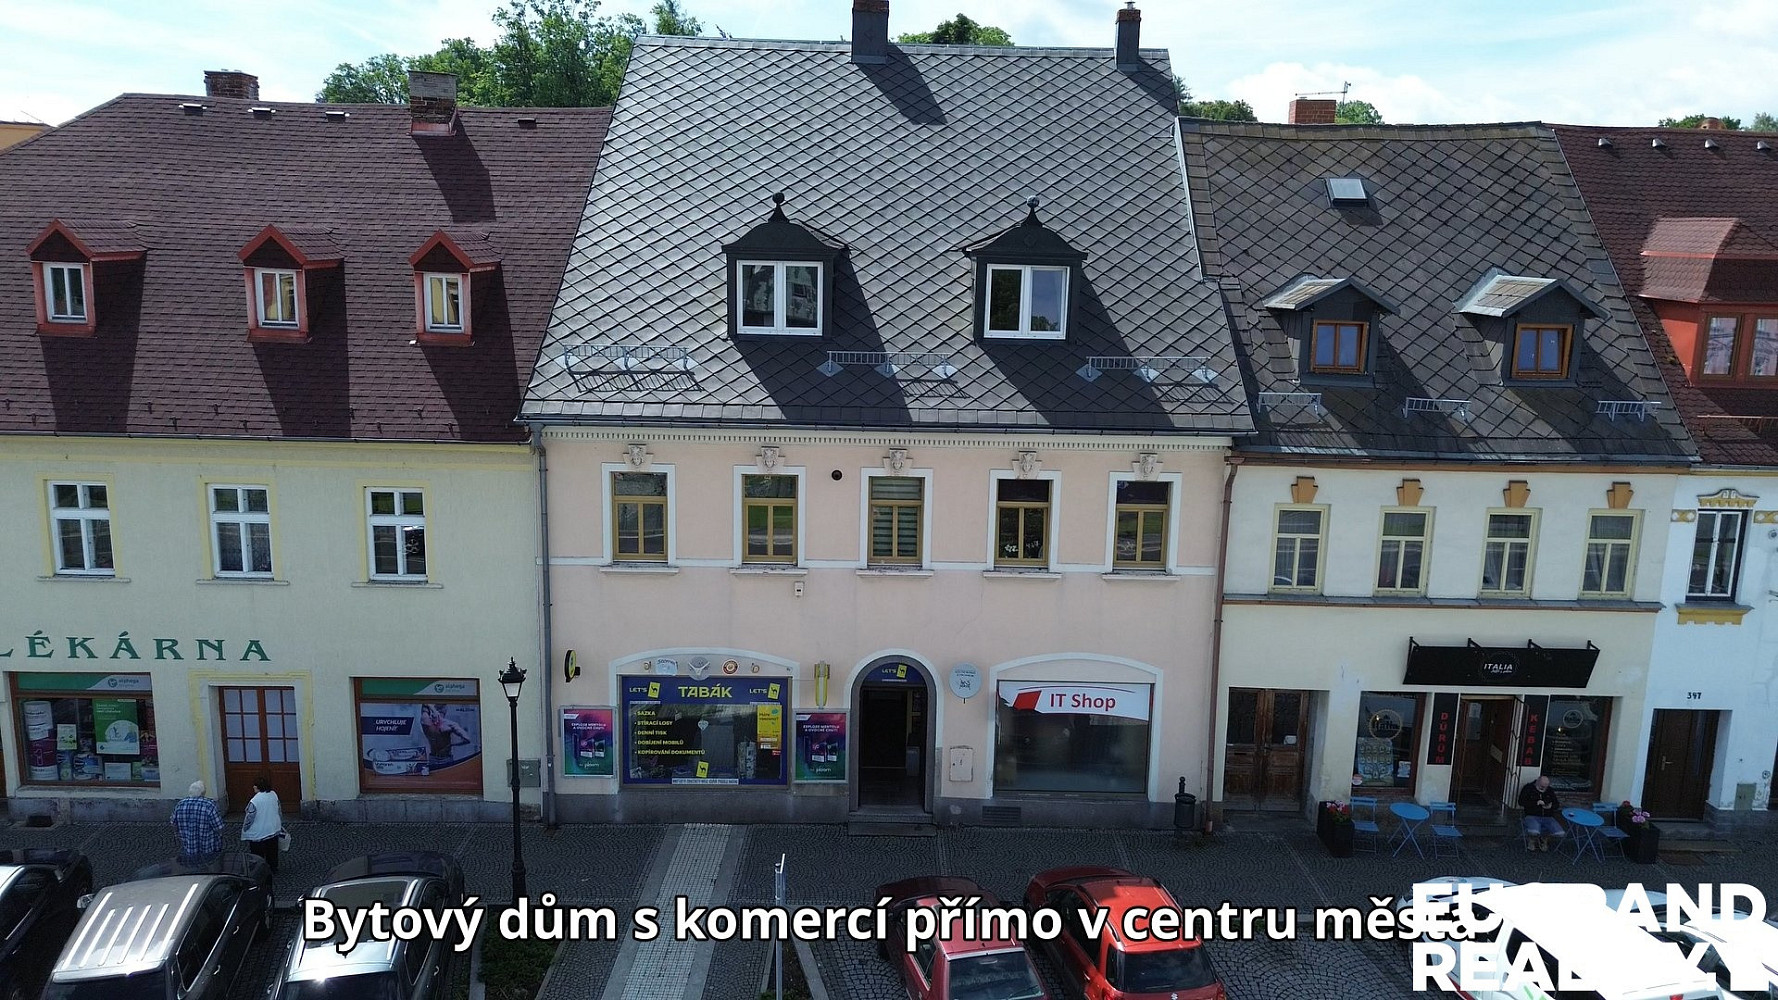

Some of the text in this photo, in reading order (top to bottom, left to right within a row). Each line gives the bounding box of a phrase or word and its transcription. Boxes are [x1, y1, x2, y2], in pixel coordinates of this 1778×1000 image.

[629, 686, 647, 694] LET'S
[677, 682, 733, 698] TABÁK
[749, 687, 767, 695] LET'S
[1686, 691, 1702, 700] 397
[1050, 693, 1117, 712] IT Shop
[1525, 714, 1539, 765] KEBAB
